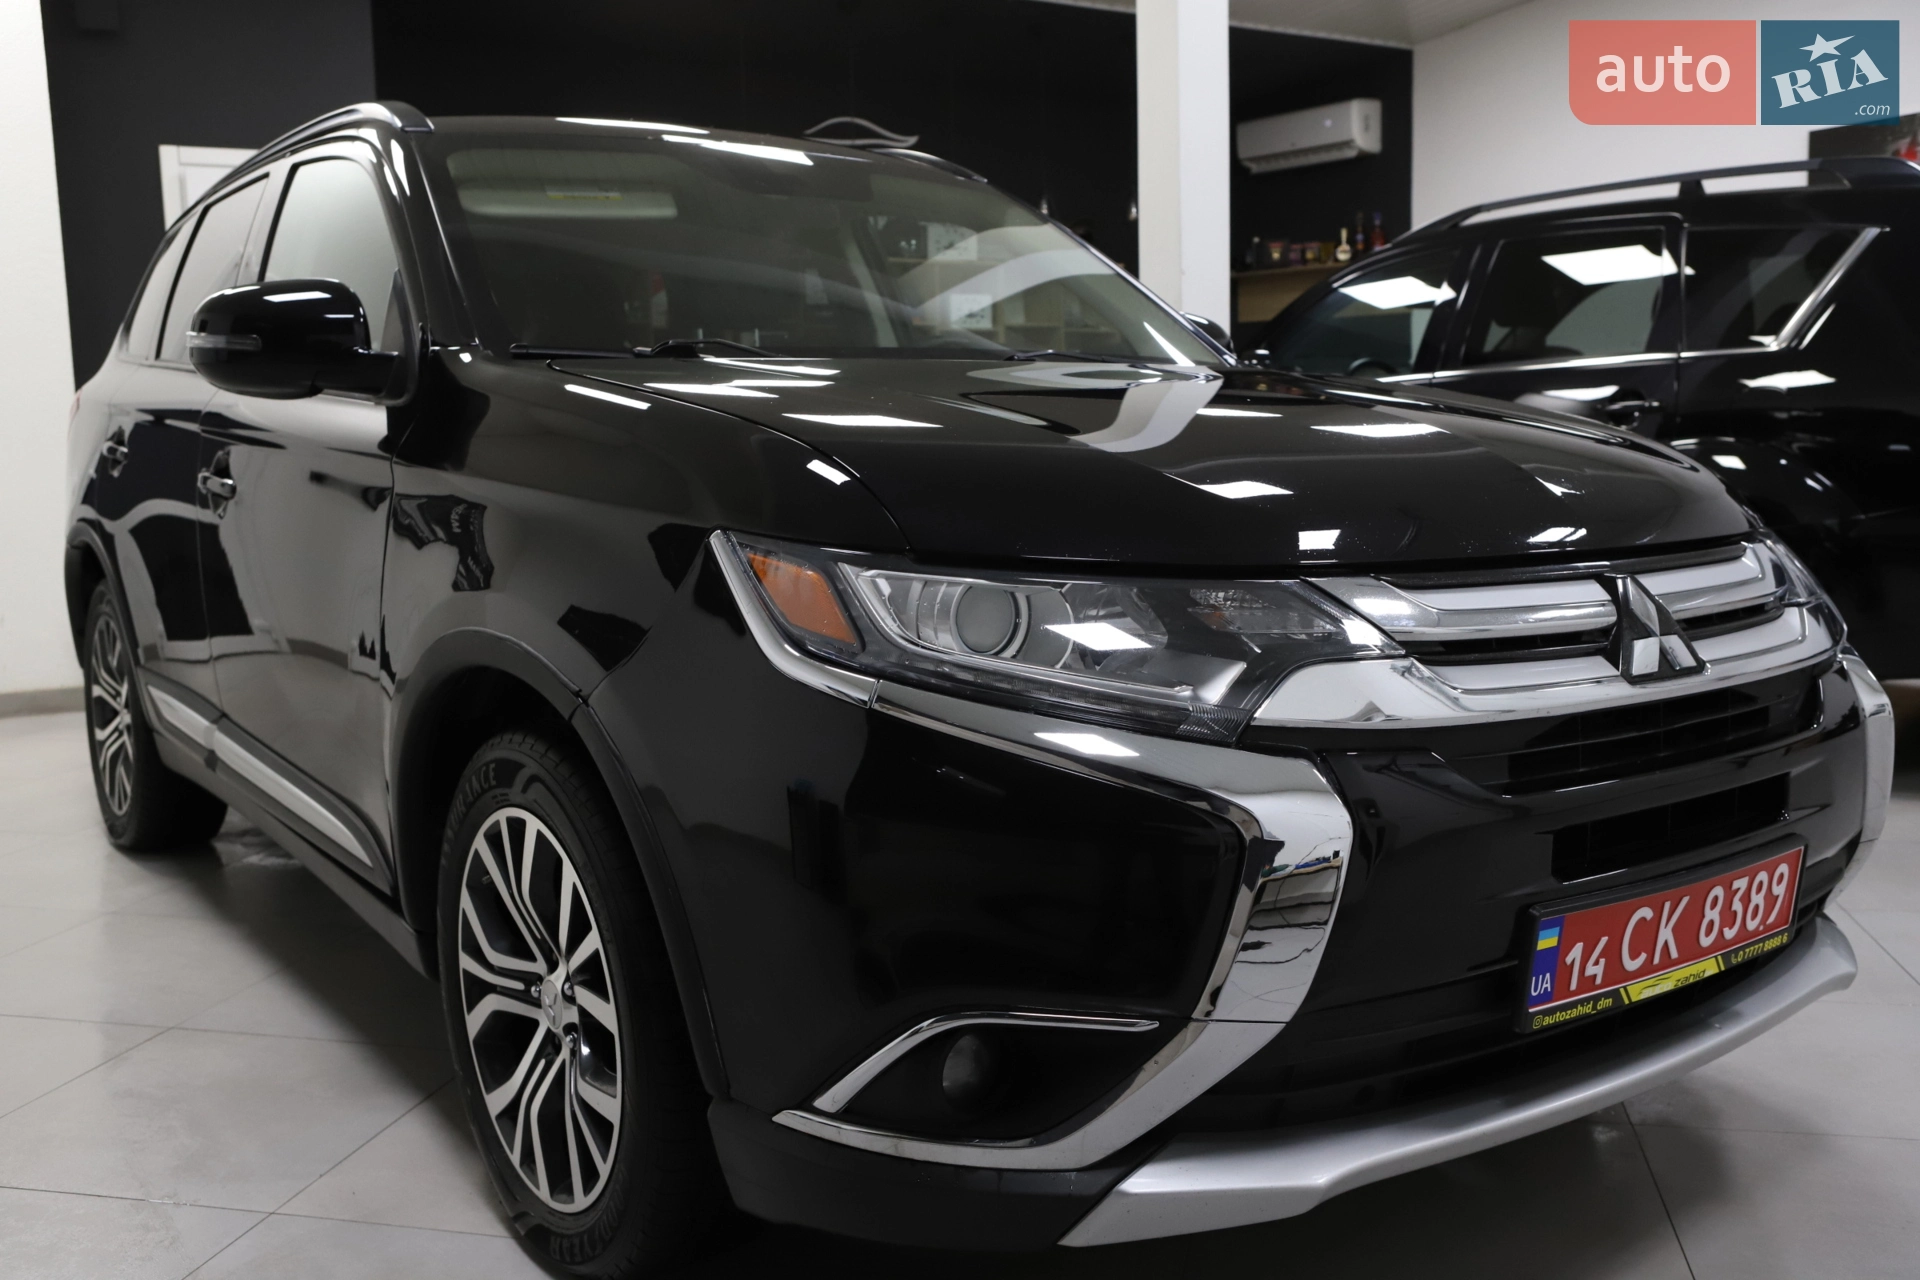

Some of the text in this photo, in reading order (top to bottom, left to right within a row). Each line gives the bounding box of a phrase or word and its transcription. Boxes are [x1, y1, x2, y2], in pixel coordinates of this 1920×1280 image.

[1564, 862, 1790, 991] 14 CK 8389
[1744, 942, 1764, 959] 7777
[1782, 932, 1788, 943] 6
[1530, 972, 1551, 996] UA
[1673, 968, 1706, 988] zahid
[1542, 997, 1613, 1026] autozahid_dm
